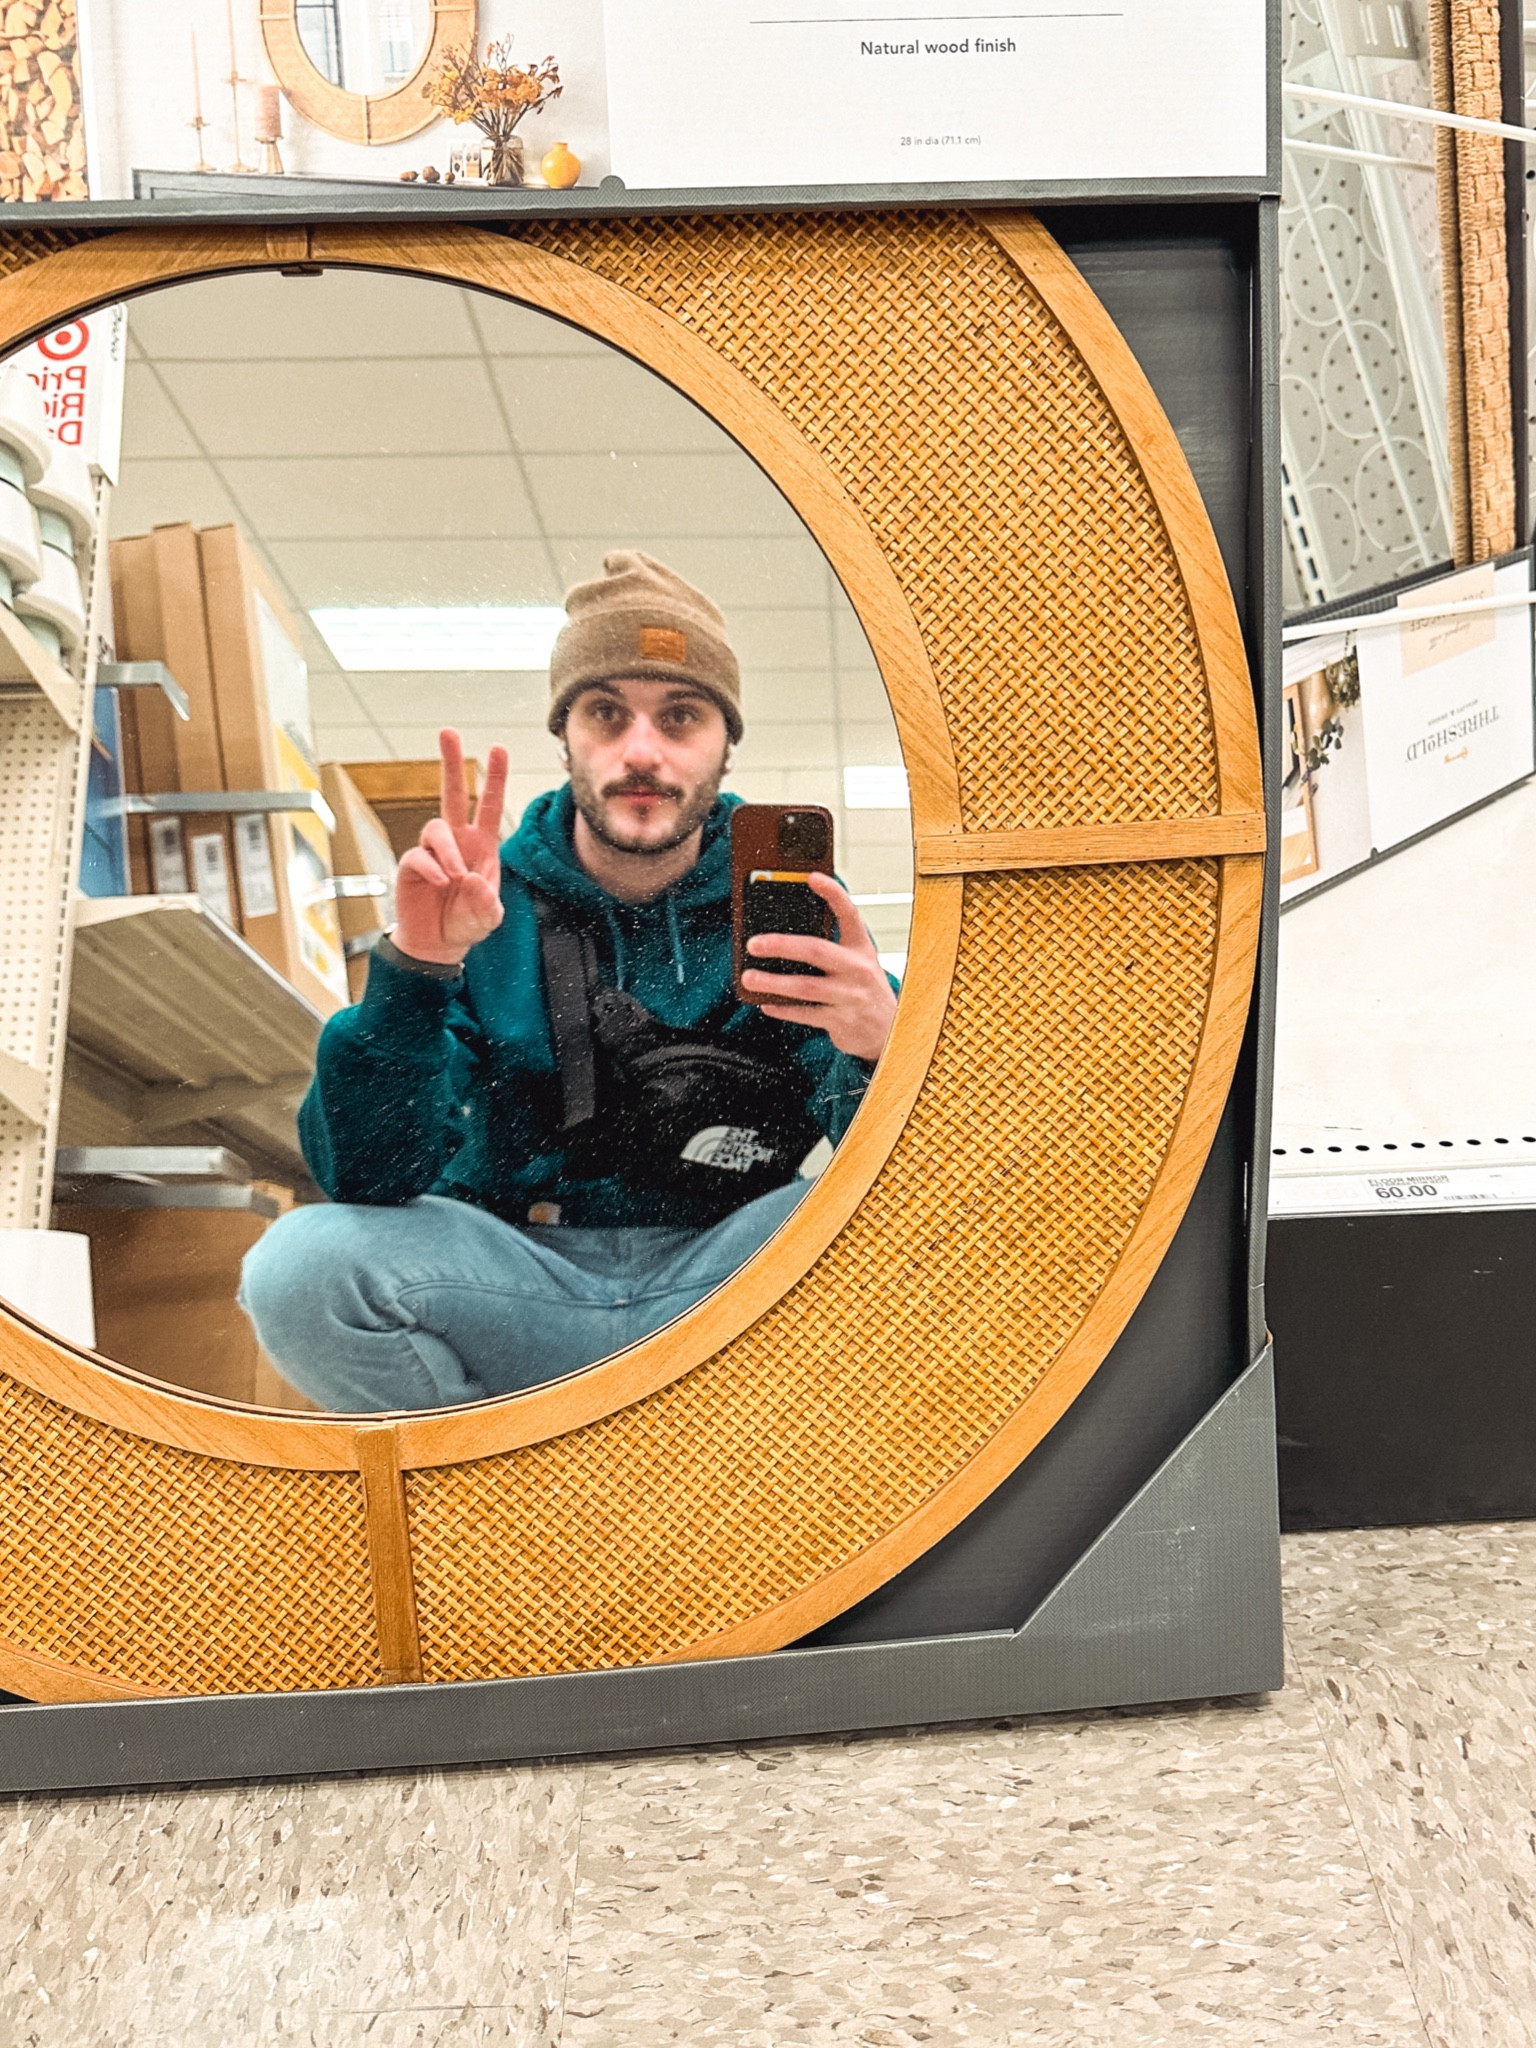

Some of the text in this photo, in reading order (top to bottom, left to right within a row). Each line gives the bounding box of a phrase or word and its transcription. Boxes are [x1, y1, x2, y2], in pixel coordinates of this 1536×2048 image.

[860, 37, 1016, 55] Natural wood finish
[900, 135, 982, 146] 28 in dia (71.1 cm)
[1405, 705, 1499, 763] THRESHOLD
[1375, 1184, 1438, 1198] 60.00
